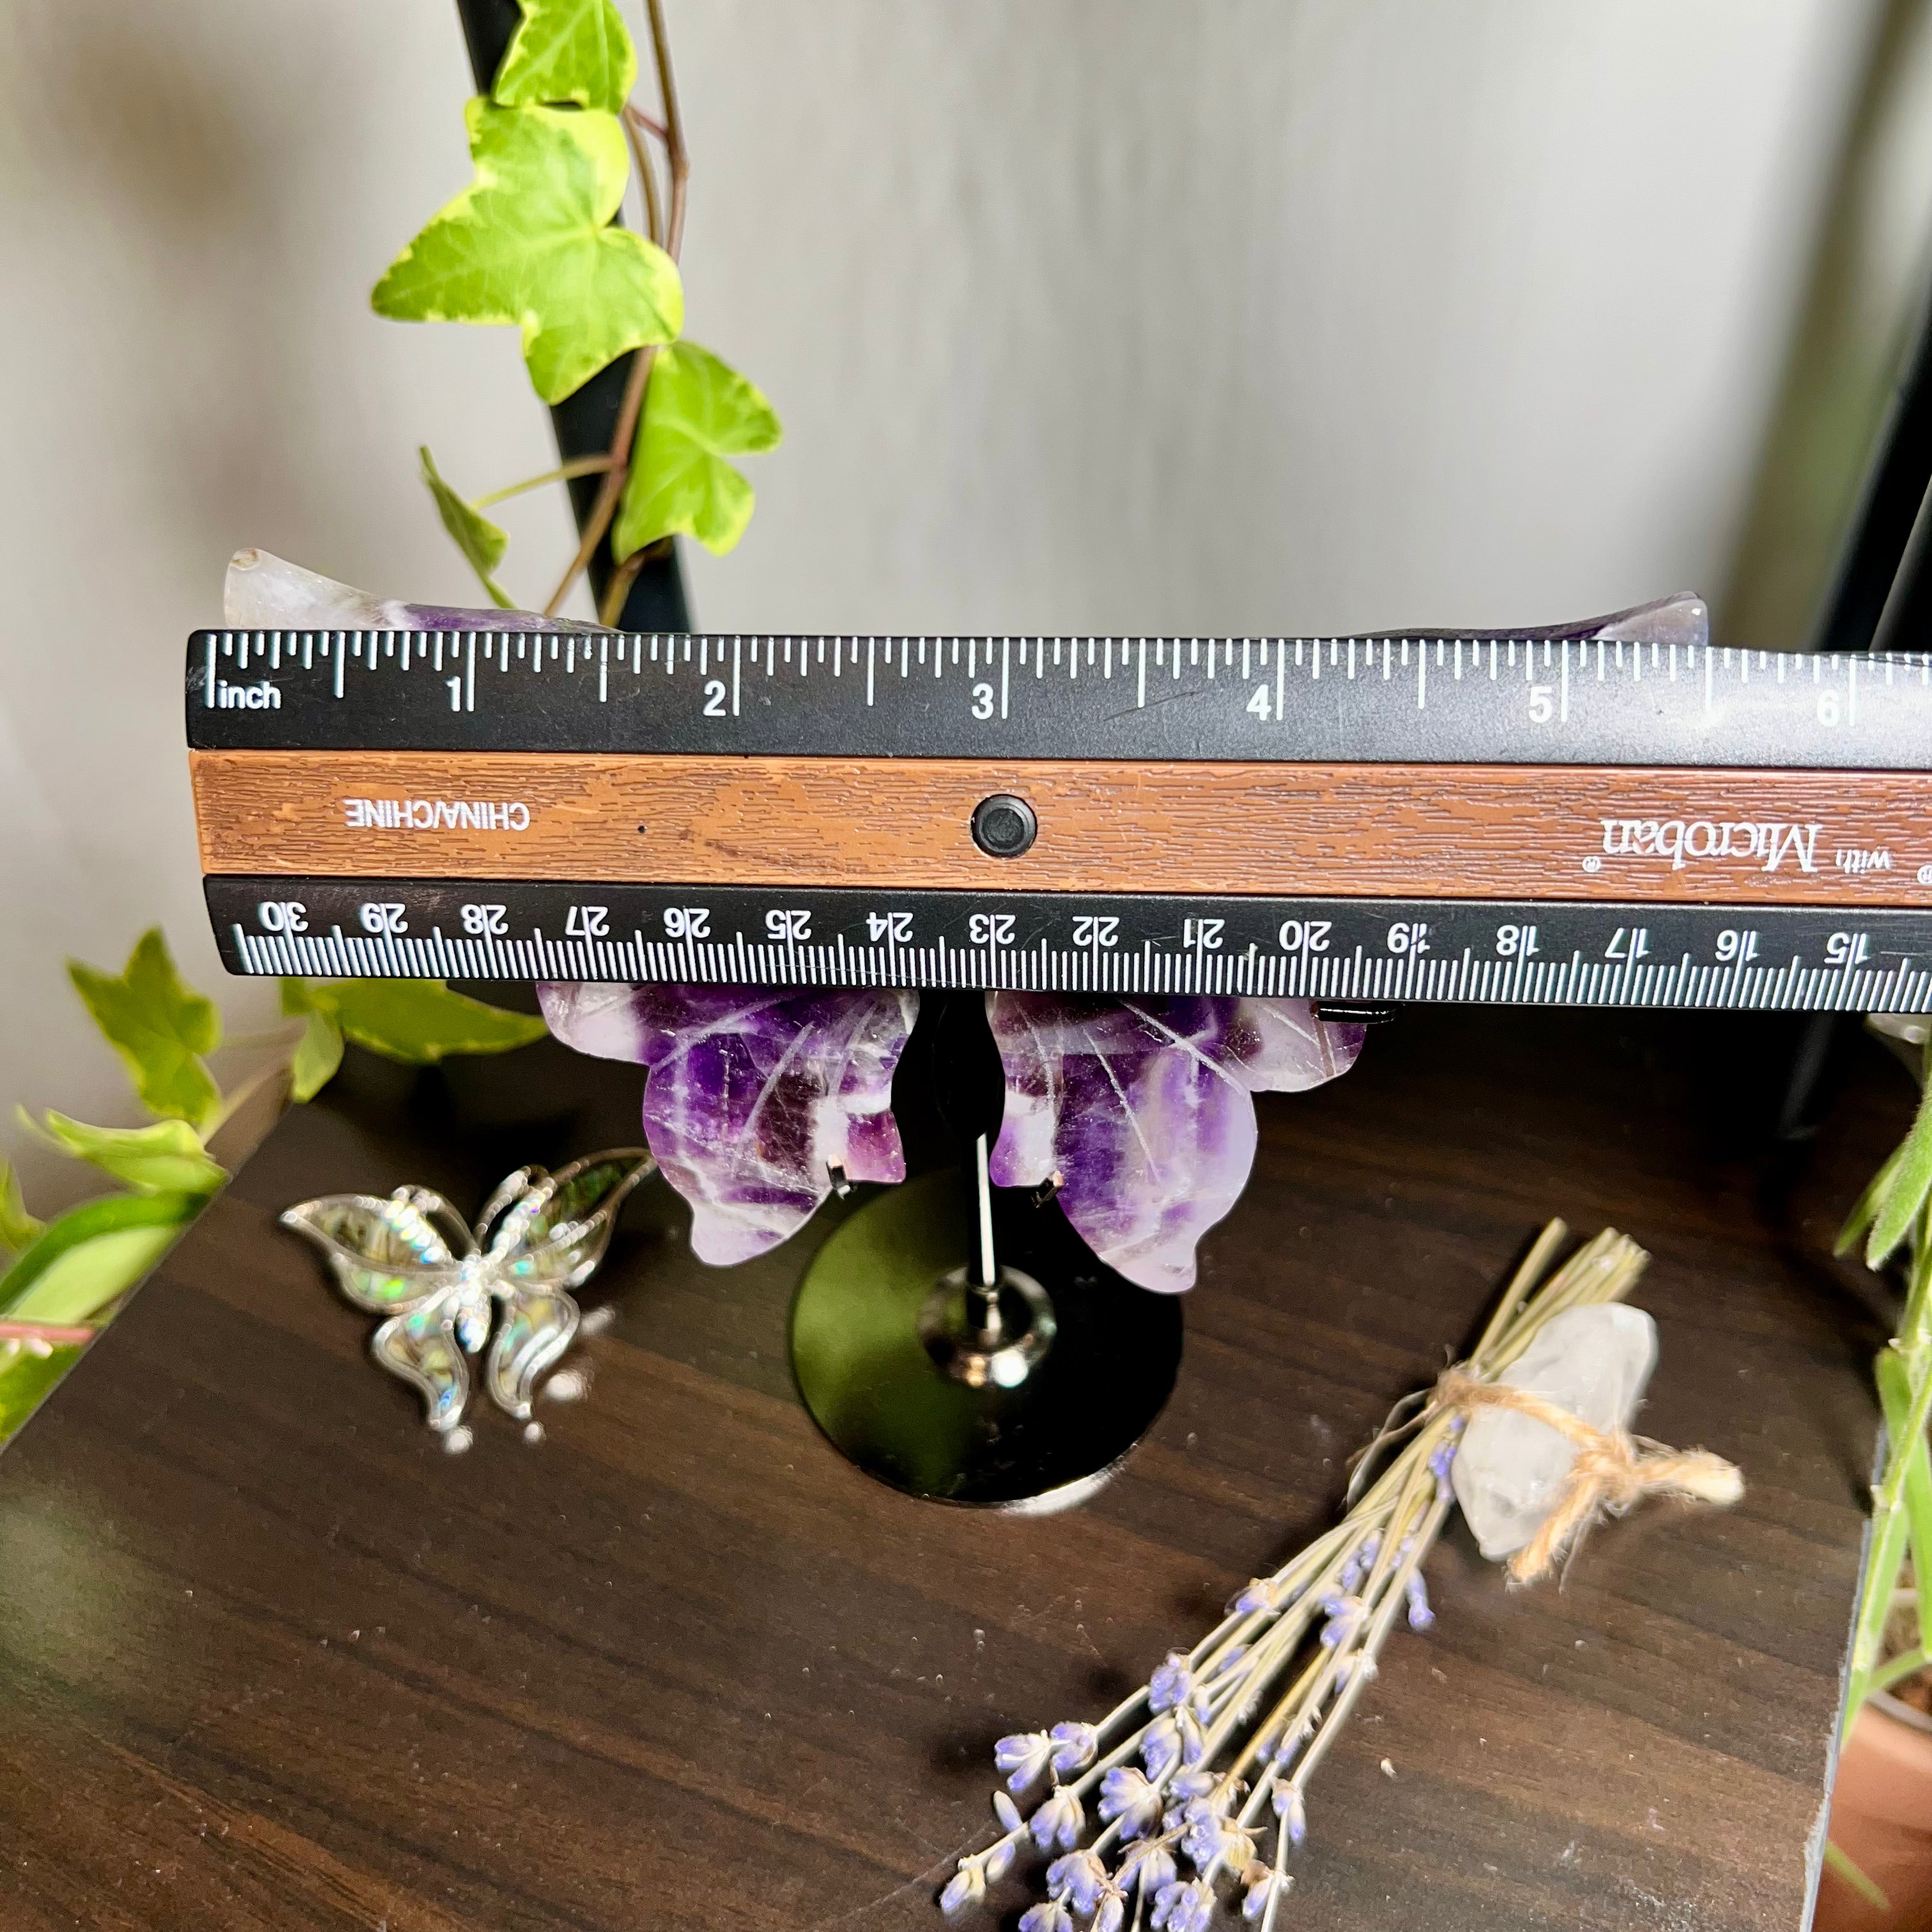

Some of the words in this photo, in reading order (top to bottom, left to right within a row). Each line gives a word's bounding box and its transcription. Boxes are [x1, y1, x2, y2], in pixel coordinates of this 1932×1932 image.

[217, 680, 281, 709] inch
[447, 675, 461, 711] 1
[703, 680, 726, 716] 2
[971, 683, 994, 719] 3
[1246, 684, 1271, 721] 4
[1528, 686, 1554, 723] 5
[1816, 689, 1840, 727] 6
[343, 799, 529, 831] CHINA/CHINE
[1836, 848, 1890, 874] with
[259, 901, 309, 932] 30
[361, 903, 408, 934] 29
[461, 904, 509, 934] 28
[565, 906, 609, 937] 27
[663, 907, 710, 938] 26
[766, 910, 812, 940] 25
[866, 912, 914, 942] 24
[969, 914, 1016, 944] 23
[1072, 916, 1120, 947] 22
[1183, 918, 1225, 949] 21
[1278, 920, 1332, 951] 20
[1387, 922, 1430, 954] 19
[1495, 924, 1540, 956] 18
[1604, 927, 1651, 959] 17
[1715, 930, 1759, 962] 16
[1824, 931, 1871, 965] 15
